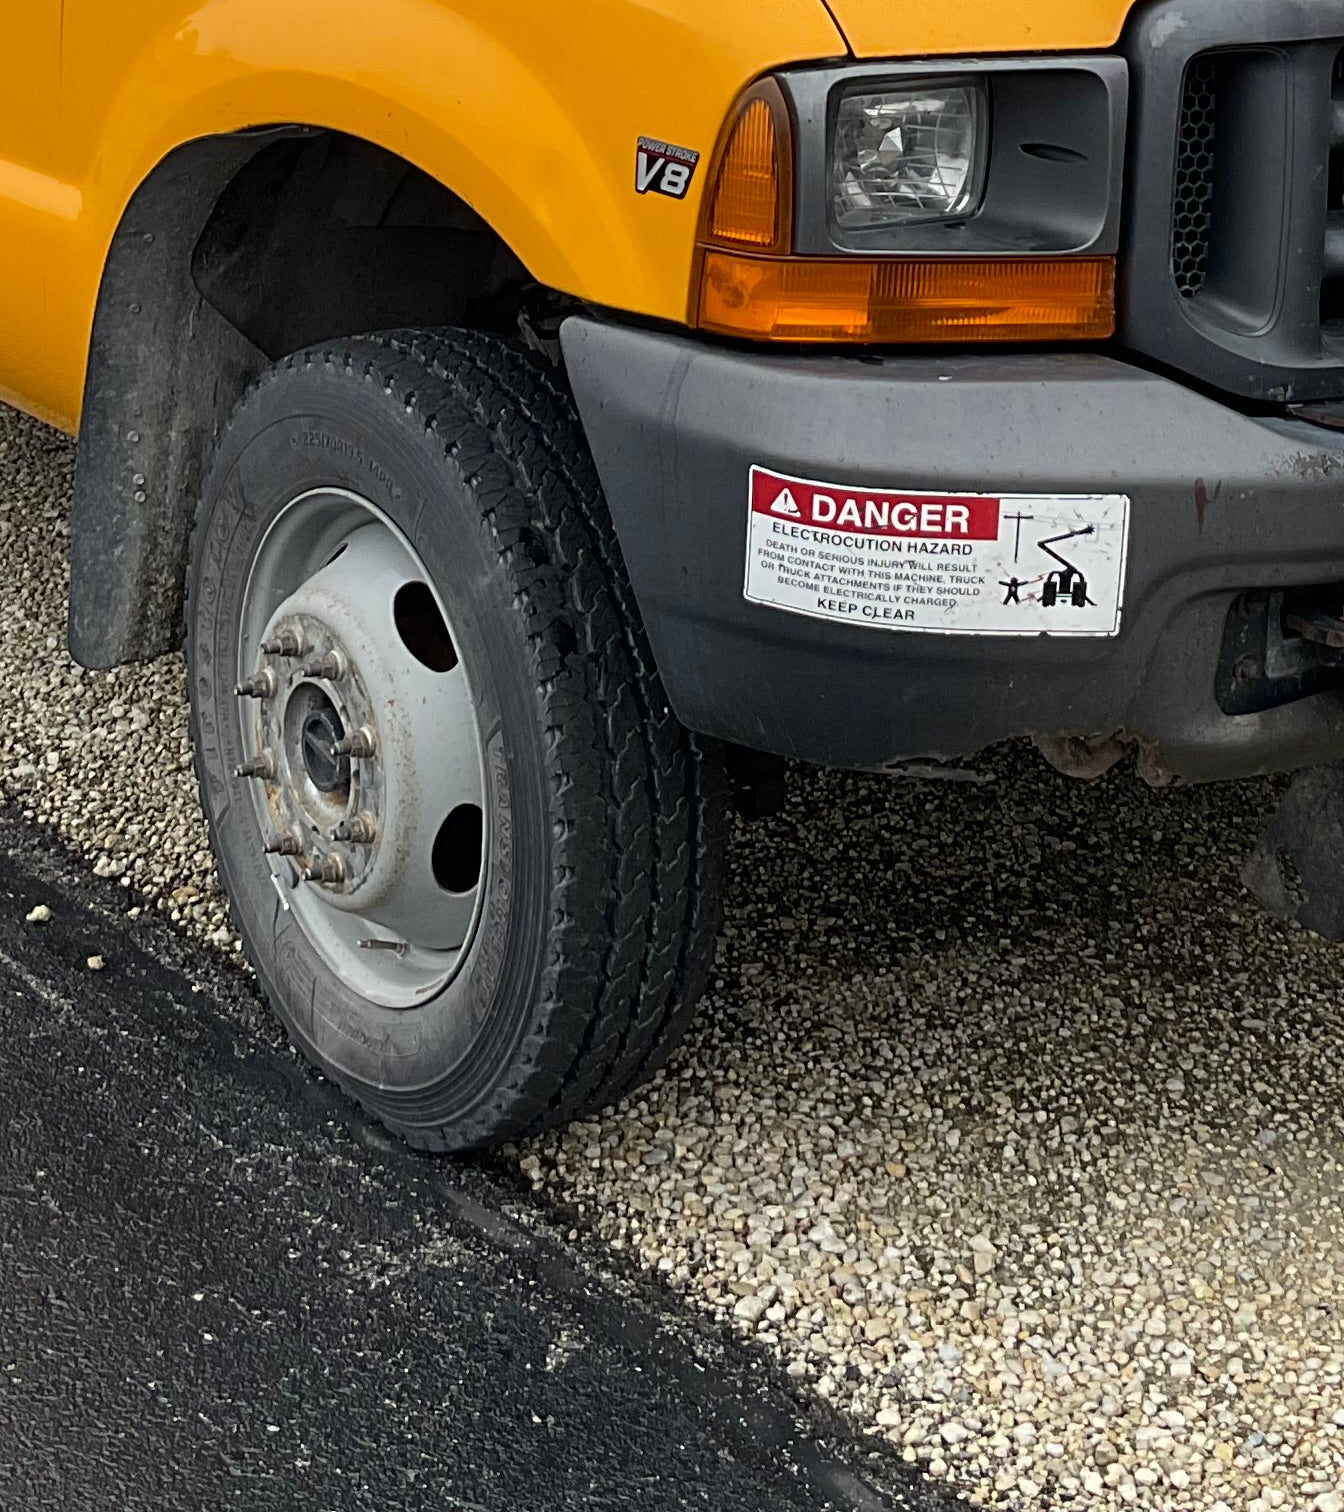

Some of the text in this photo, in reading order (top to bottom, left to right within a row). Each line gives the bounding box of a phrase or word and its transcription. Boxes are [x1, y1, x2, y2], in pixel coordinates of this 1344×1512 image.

[638, 137, 698, 163] POWER STROKE
[636, 151, 690, 195] V8
[812, 493, 970, 534] DANGER
[766, 539, 977, 573] DEATH OR SERIOUS INJURY WILL RESULT
[772, 521, 973, 556] ELECTROCUTION HAZARD
[757, 548, 785, 562] FROM
[787, 556, 836, 573] CONTACT
[838, 566, 865, 577] WITH
[868, 569, 892, 580] THIS
[949, 576, 986, 585] TRUCK
[761, 560, 981, 597] OR TRUCK ATTACHMENTS IF THEY SHOULD
[777, 576, 820, 593] BECOME
[823, 586, 901, 604] ELECTRICALLY
[817, 597, 915, 620] KEEP CLEAR
